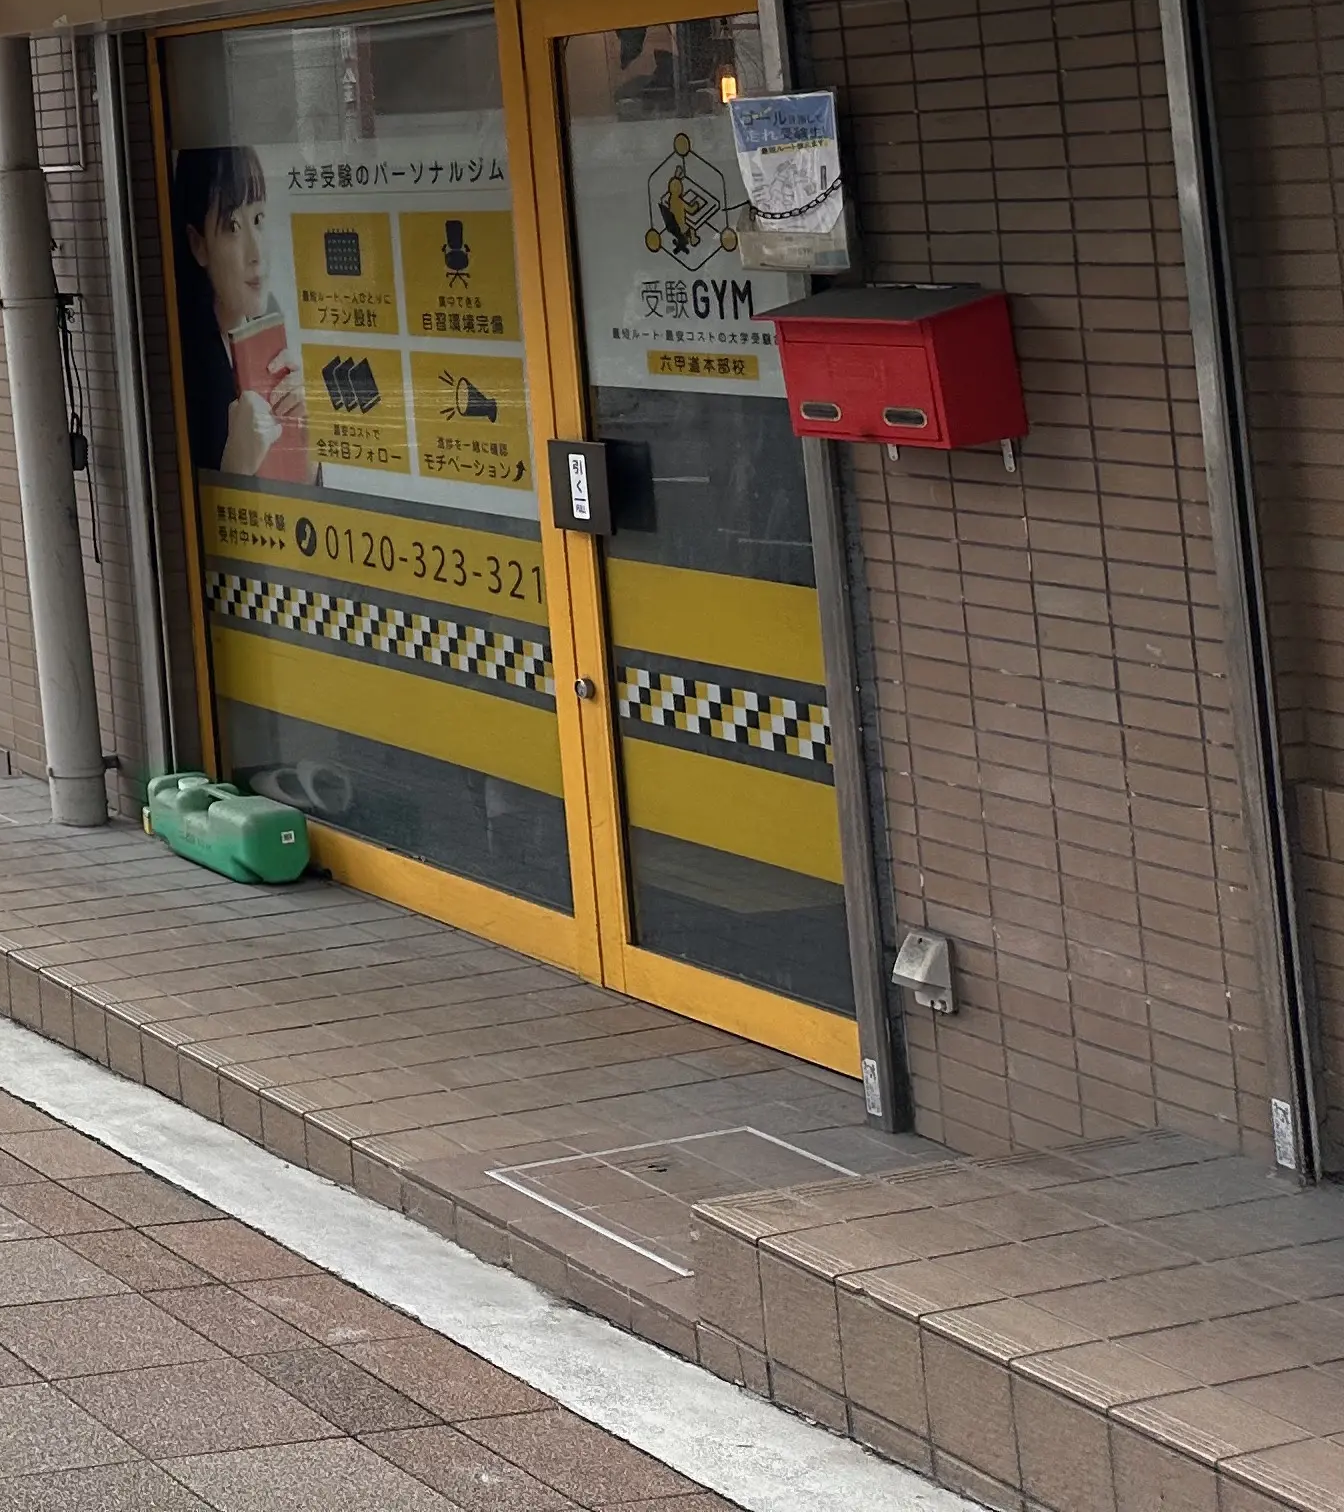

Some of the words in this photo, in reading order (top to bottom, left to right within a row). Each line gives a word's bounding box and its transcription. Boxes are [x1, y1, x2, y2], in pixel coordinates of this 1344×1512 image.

[288, 157, 504, 189] 大学受験のパーソナルジム
[641, 279, 754, 320] 受験GYM
[317, 307, 377, 327] プラン設計
[423, 312, 504, 334] 自習環境完備
[660, 355, 745, 375] 六甲道本部校
[317, 439, 401, 463] 全科目フォロー
[424, 453, 511, 479] モチベーション
[573, 460, 583, 494] 引く
[325, 525, 543, 605] 0120-323-321
